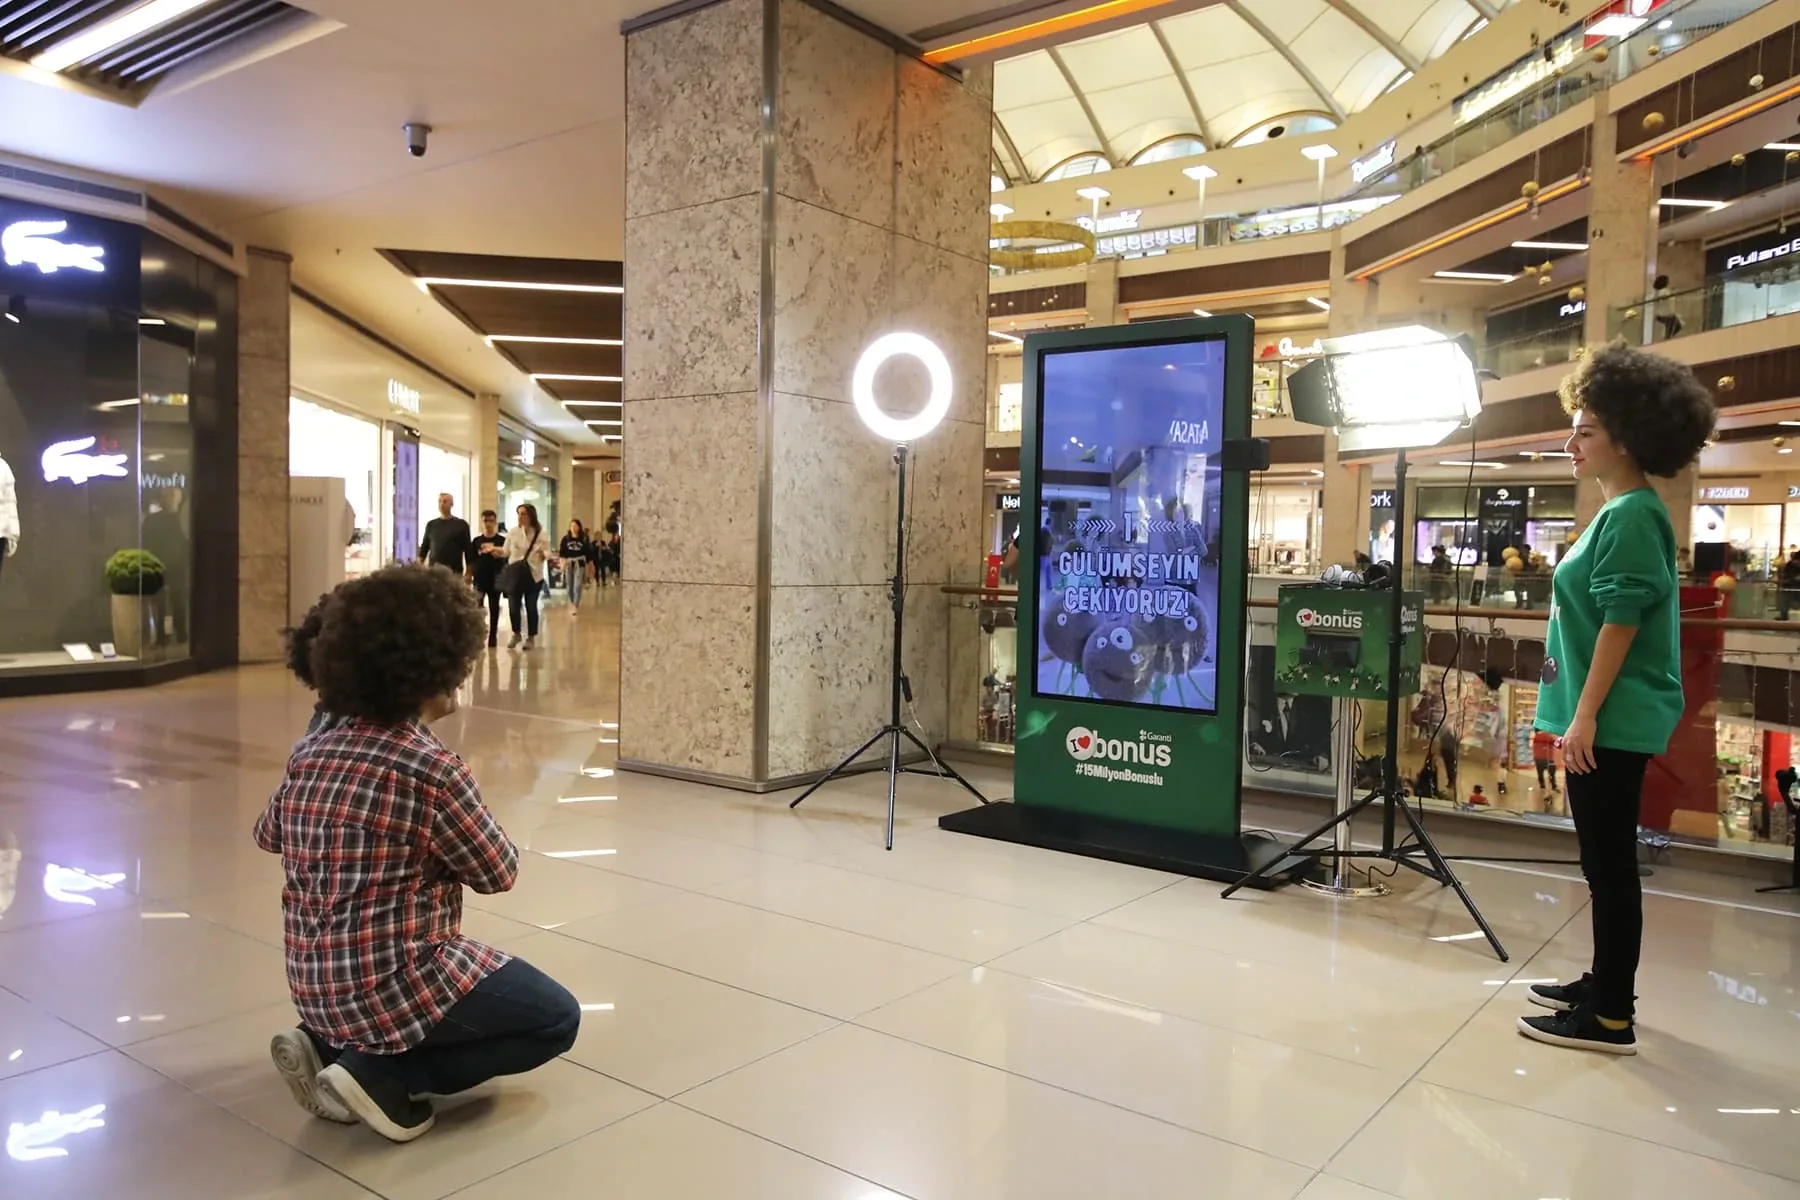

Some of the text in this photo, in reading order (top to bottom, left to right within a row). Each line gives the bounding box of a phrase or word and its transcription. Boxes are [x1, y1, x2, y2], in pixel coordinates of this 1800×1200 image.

[1059, 548, 1199, 581] GÜLÜMSEYİN
[1065, 582, 1189, 617] ÇEKİYORUZ!
[1312, 610, 1362, 629] bonus
[1092, 730, 1172, 767] bonus
[1147, 731, 1172, 743] Garanti
[1075, 763, 1163, 786] #15MilyonBonuslu
